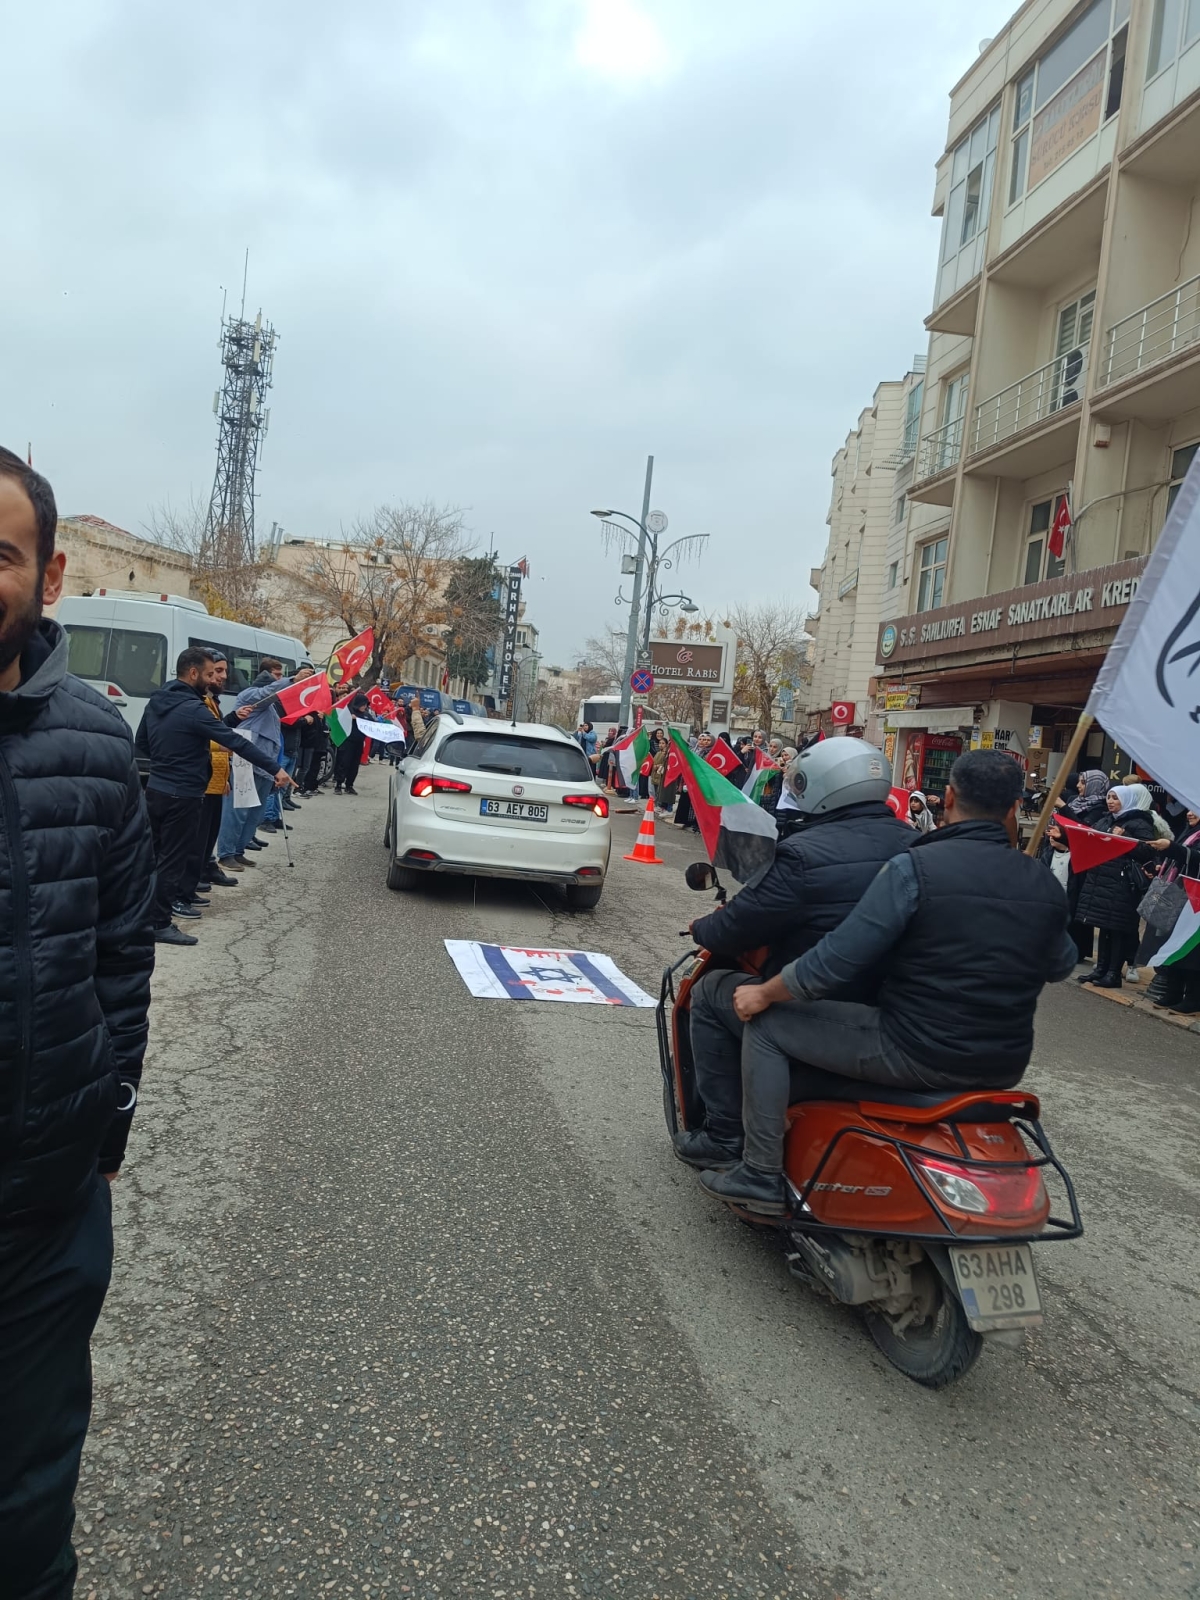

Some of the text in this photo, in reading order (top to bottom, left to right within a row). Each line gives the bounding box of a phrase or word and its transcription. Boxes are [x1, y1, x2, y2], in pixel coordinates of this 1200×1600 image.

[507, 580, 519, 635] URHAY
[970, 607, 1004, 634] ESNAF
[1007, 587, 1094, 626] SANATKARLAR
[501, 641, 514, 695] HOTEL
[650, 665, 684, 677] HOTEL
[995, 729, 1013, 741] KAR
[487, 801, 546, 818] 63 AEY 805
[959, 1252, 1027, 1279] 63AHA
[988, 1283, 1026, 1312] 298
